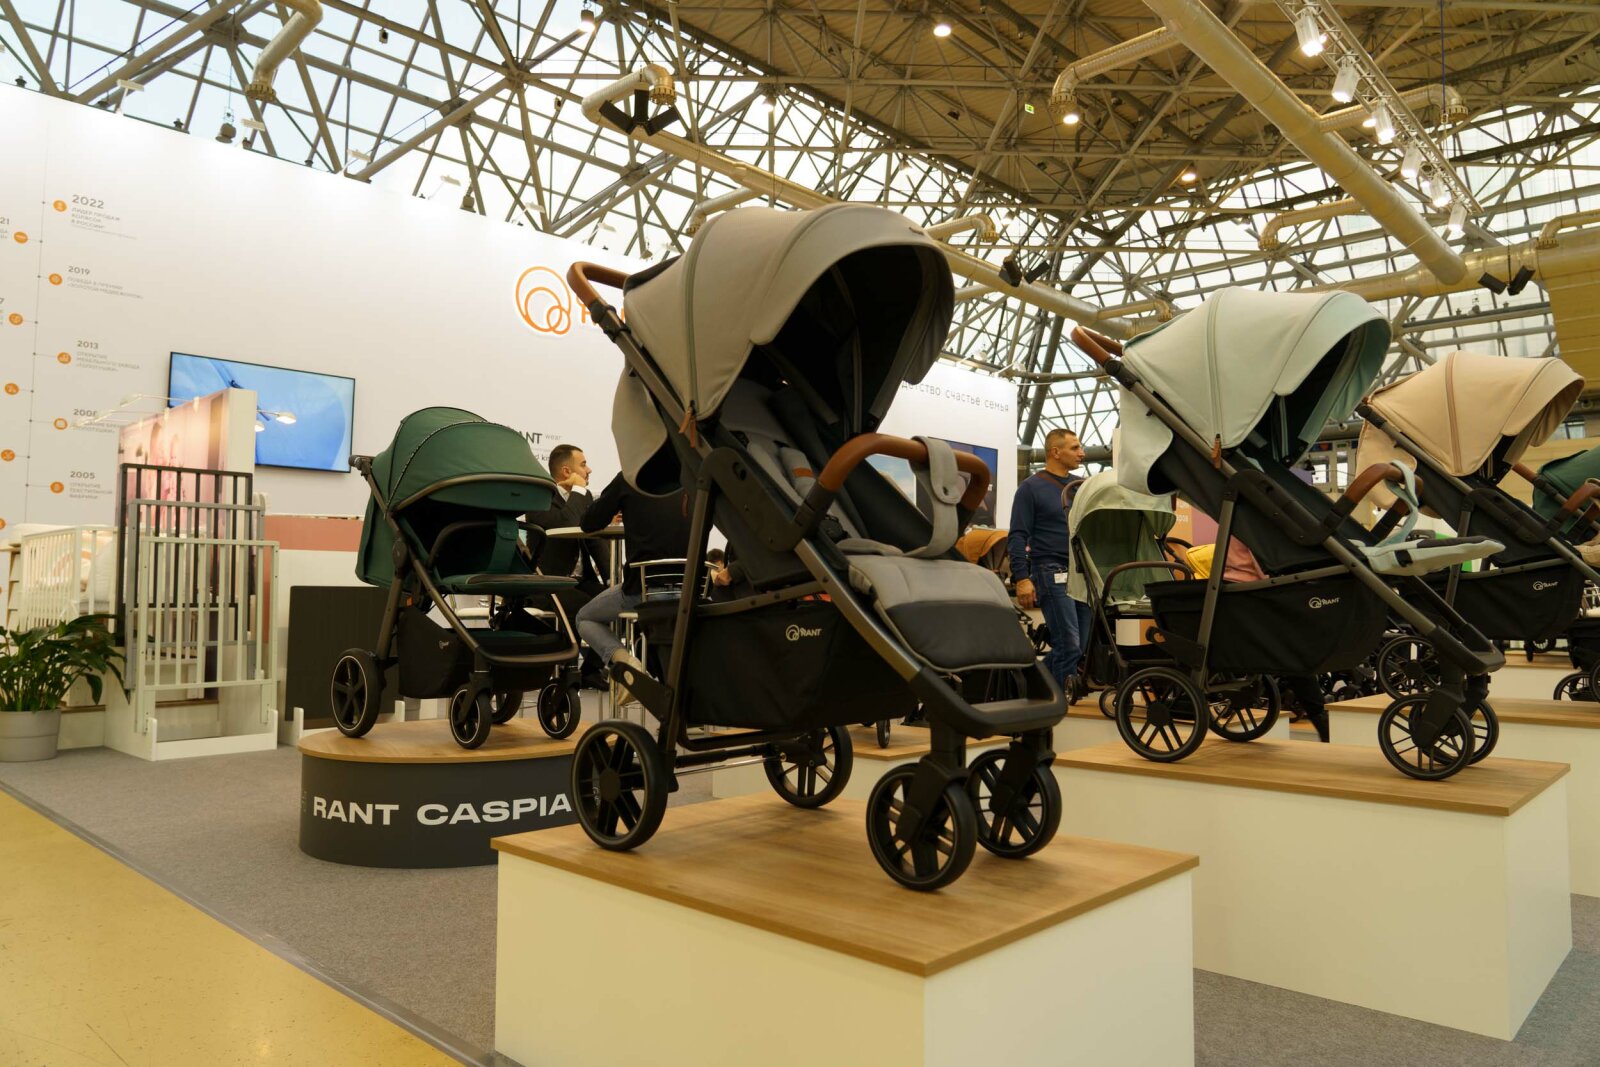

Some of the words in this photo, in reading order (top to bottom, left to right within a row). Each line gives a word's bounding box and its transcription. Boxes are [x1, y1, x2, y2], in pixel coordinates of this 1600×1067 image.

[72, 194, 104, 209] 2022
[68, 265, 90, 275] 2019
[77, 340, 99, 349] 2013
[70, 470, 95, 479] 2005
[1321, 597, 1341, 606] RANT
[800, 627, 823, 638] RANT
[313, 796, 400, 826] RANT
[416, 793, 573, 826] CASPIA
